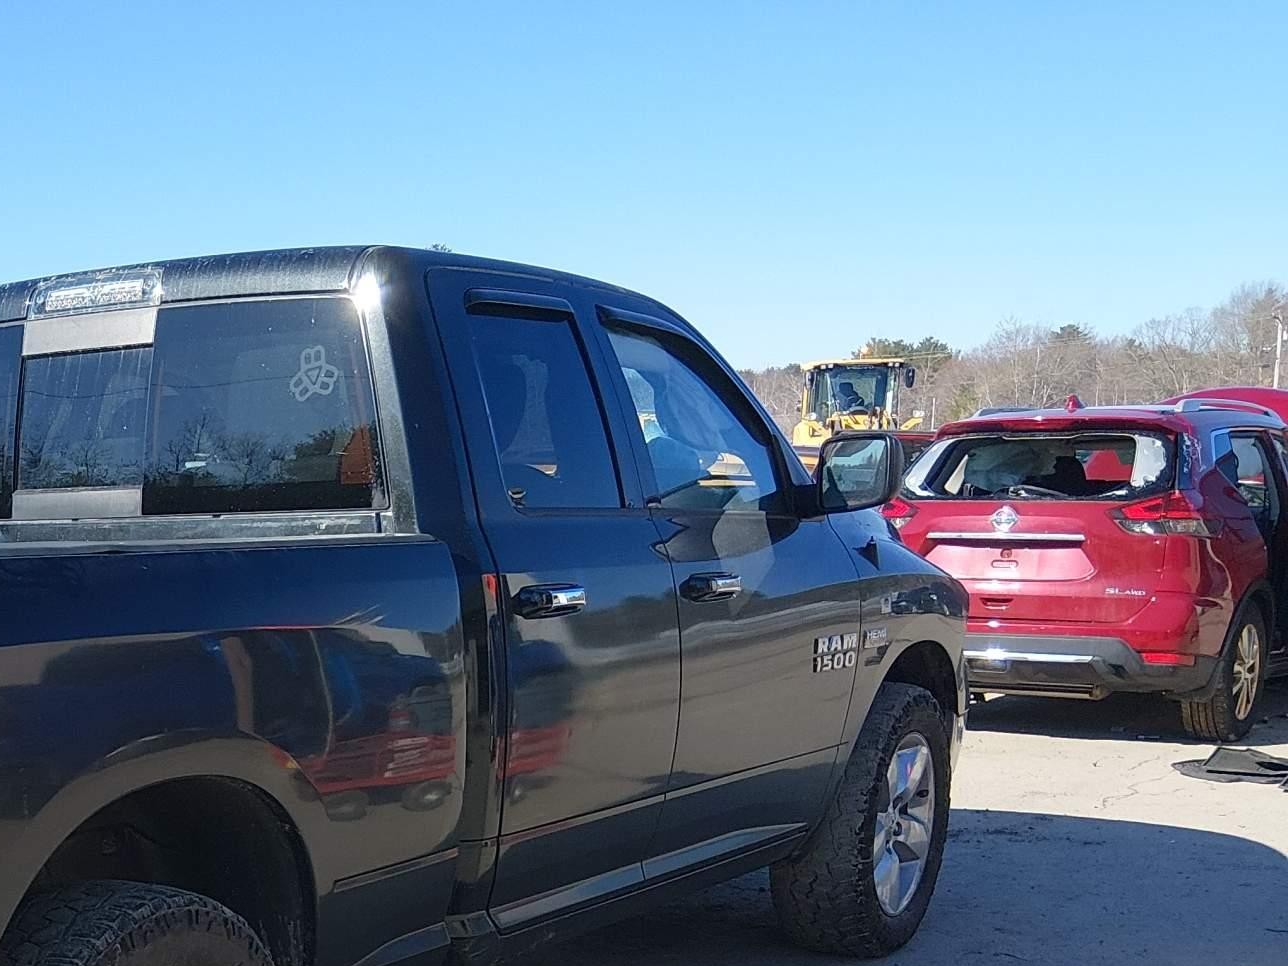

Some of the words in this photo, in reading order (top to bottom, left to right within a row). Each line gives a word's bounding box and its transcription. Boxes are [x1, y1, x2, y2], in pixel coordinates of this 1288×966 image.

[815, 633, 857, 654] RAM
[865, 628, 887, 640] HEMI
[814, 651, 856, 673] 1500
